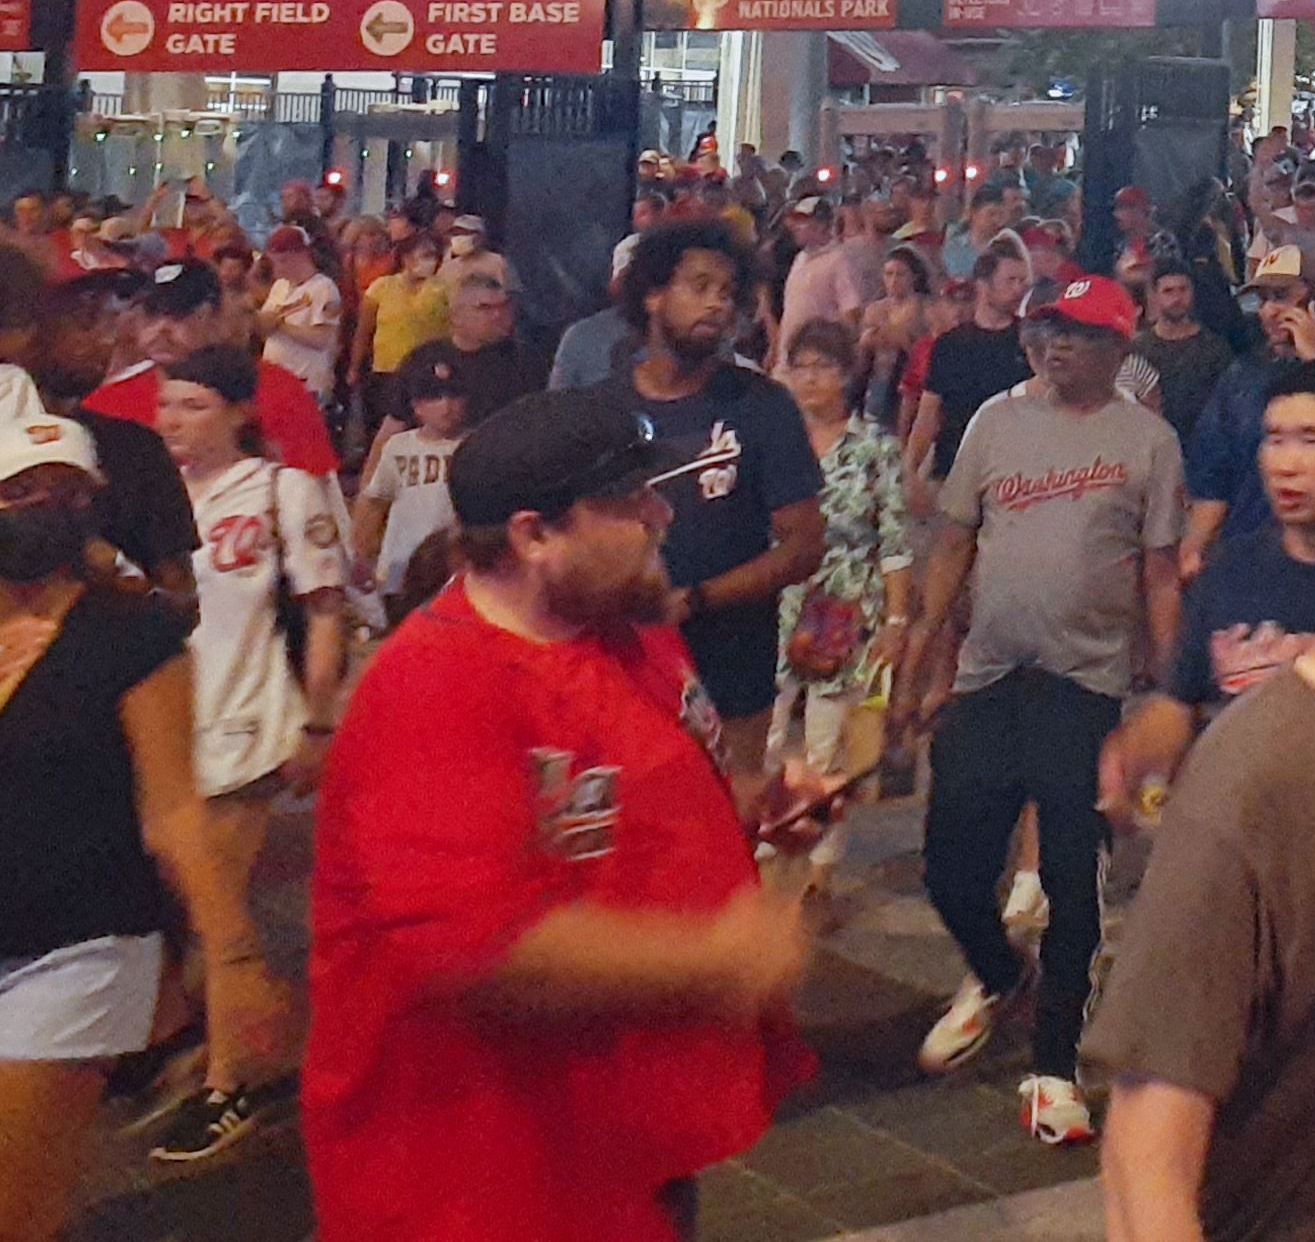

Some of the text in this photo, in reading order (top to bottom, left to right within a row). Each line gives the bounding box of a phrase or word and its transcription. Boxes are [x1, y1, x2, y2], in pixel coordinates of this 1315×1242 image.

[167, 2, 331, 24] RIGHT FIELD
[427, 2, 580, 24] FIRST BASE
[738, 0, 835, 19] NATIONALS
[166, 33, 237, 55] GATE
[426, 33, 497, 55] GATE
